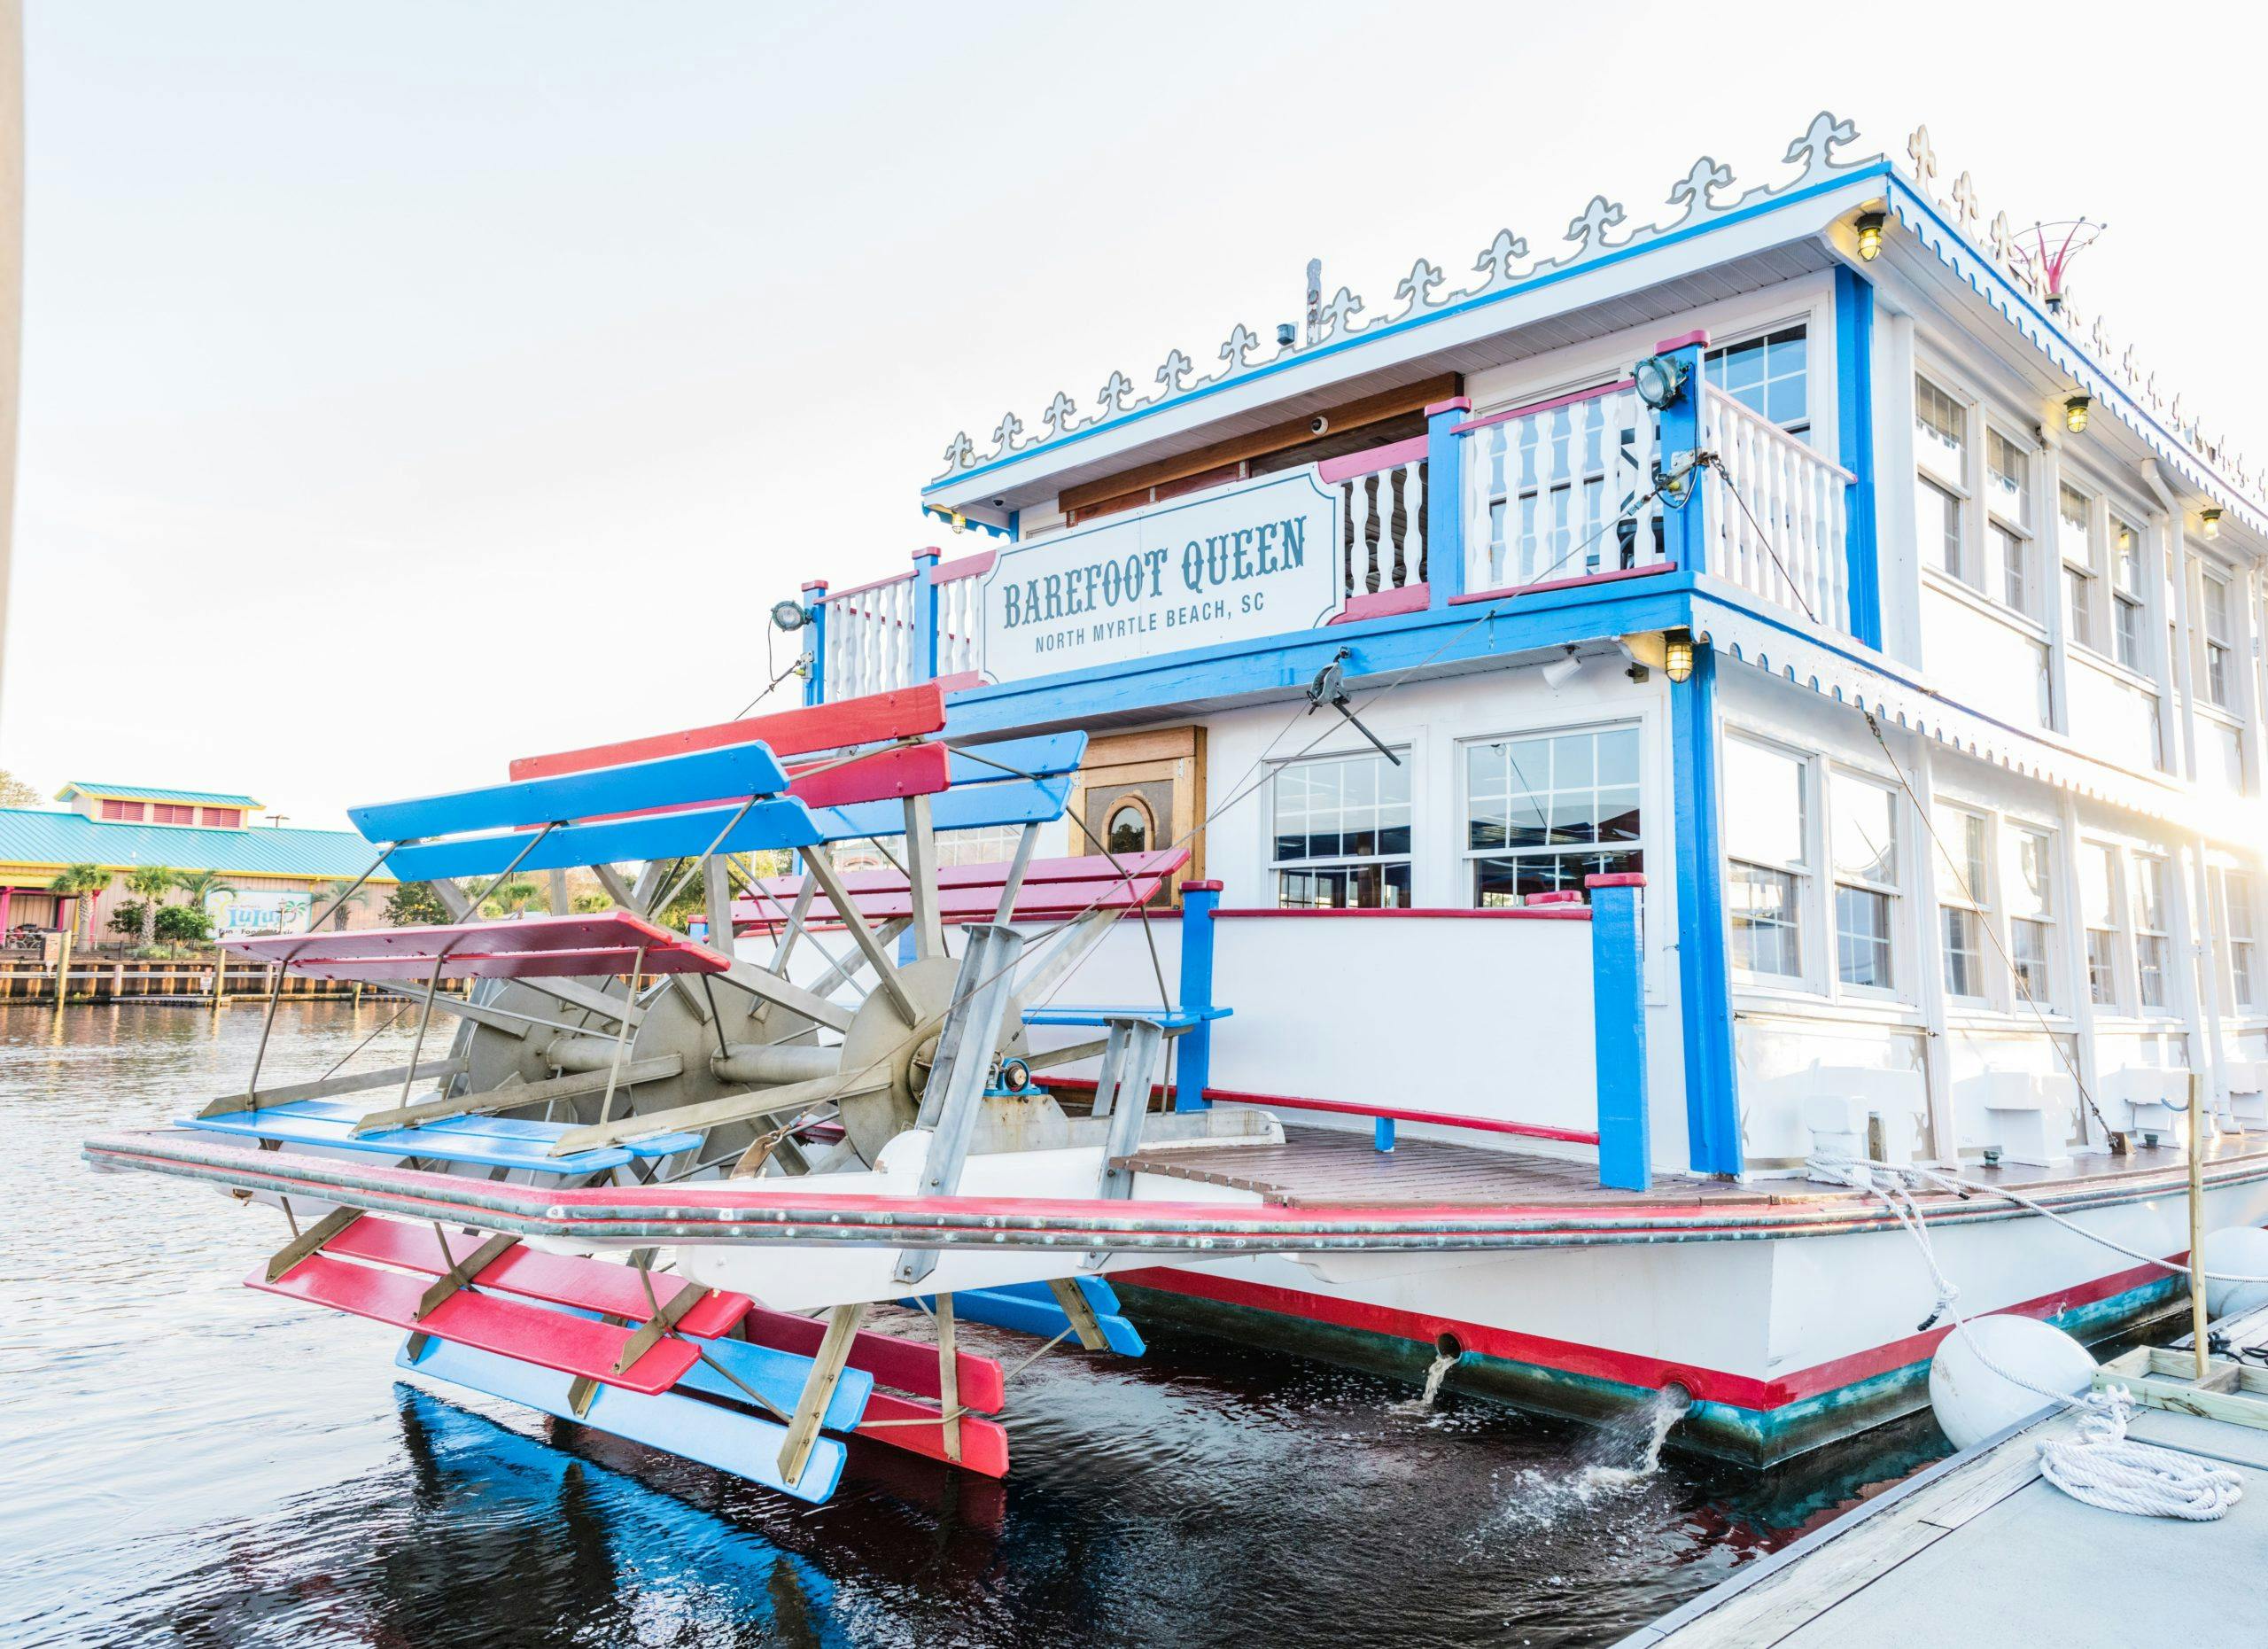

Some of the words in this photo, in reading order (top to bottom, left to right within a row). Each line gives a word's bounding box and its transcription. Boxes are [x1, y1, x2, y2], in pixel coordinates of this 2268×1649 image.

[1003, 547, 1169, 629] BAREFOOT
[1181, 516, 1308, 594] QUEEN
[1035, 627, 1085, 653] NORTH
[1093, 612, 1157, 642] MYRTLE
[1167, 599, 1232, 627] BEACH,
[1241, 592, 1265, 614] SC
